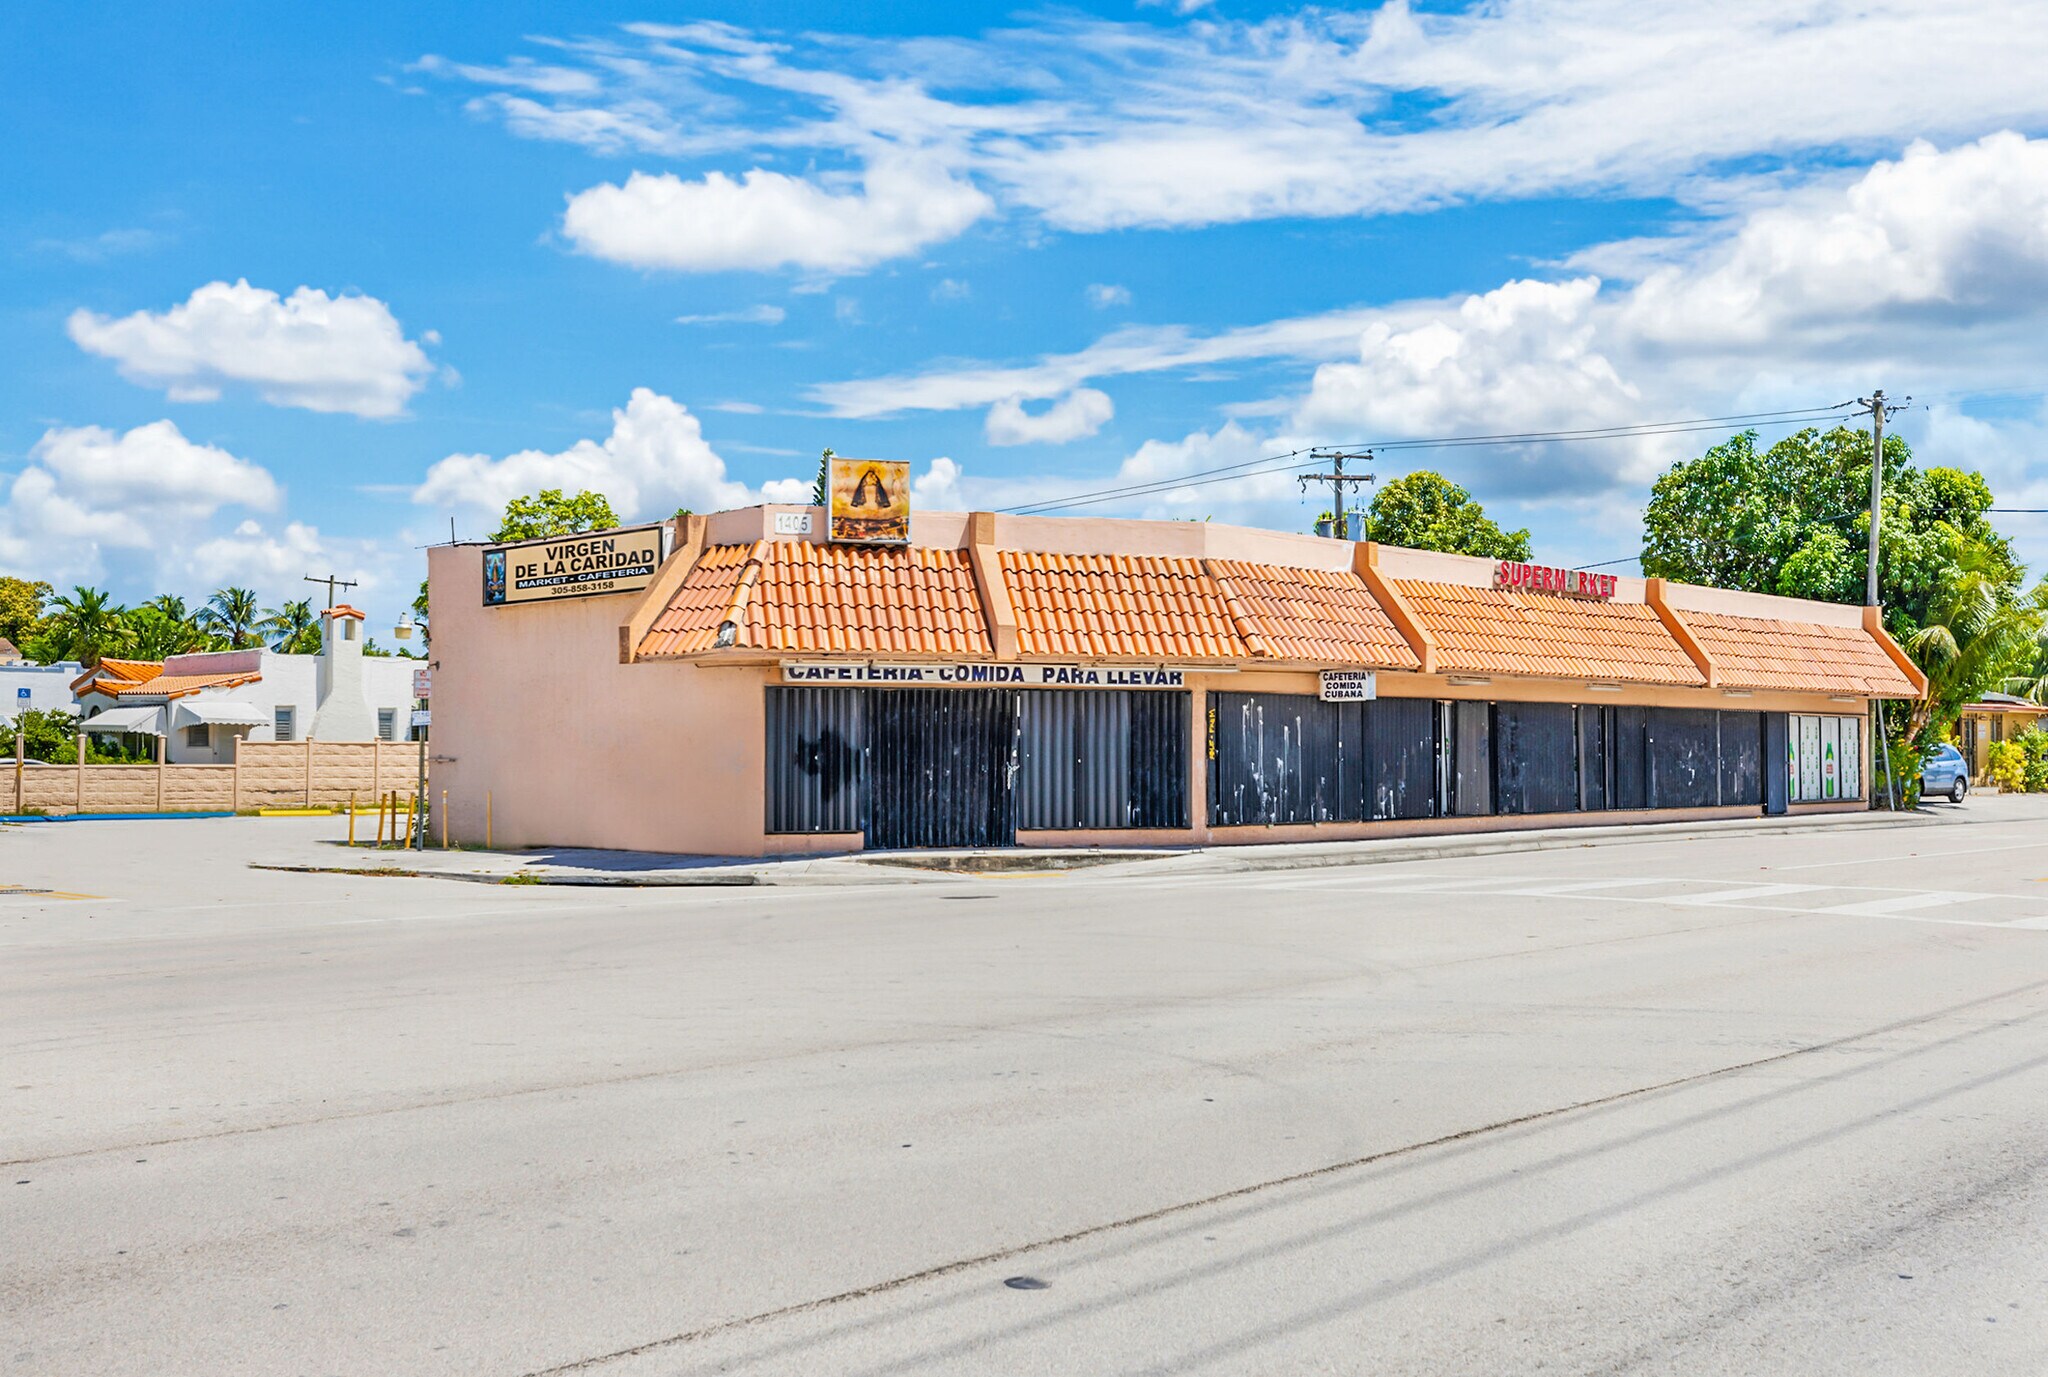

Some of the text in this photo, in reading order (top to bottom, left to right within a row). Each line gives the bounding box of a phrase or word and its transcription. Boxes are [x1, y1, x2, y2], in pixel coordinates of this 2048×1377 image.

[546, 539, 615, 560] VIRGEN
[515, 549, 654, 579] DE LA CARIDAD
[518, 576, 567, 588] MARKET
[577, 566, 648, 582] CAFETERIA
[551, 581, 614, 594] 305-858-3158
[1042, 667, 1099, 684] PARA
[1107, 671, 1182, 685] LLEVAR
[1323, 672, 1366, 681] CAFETERIA
[1324, 690, 1363, 698] CUBANA
